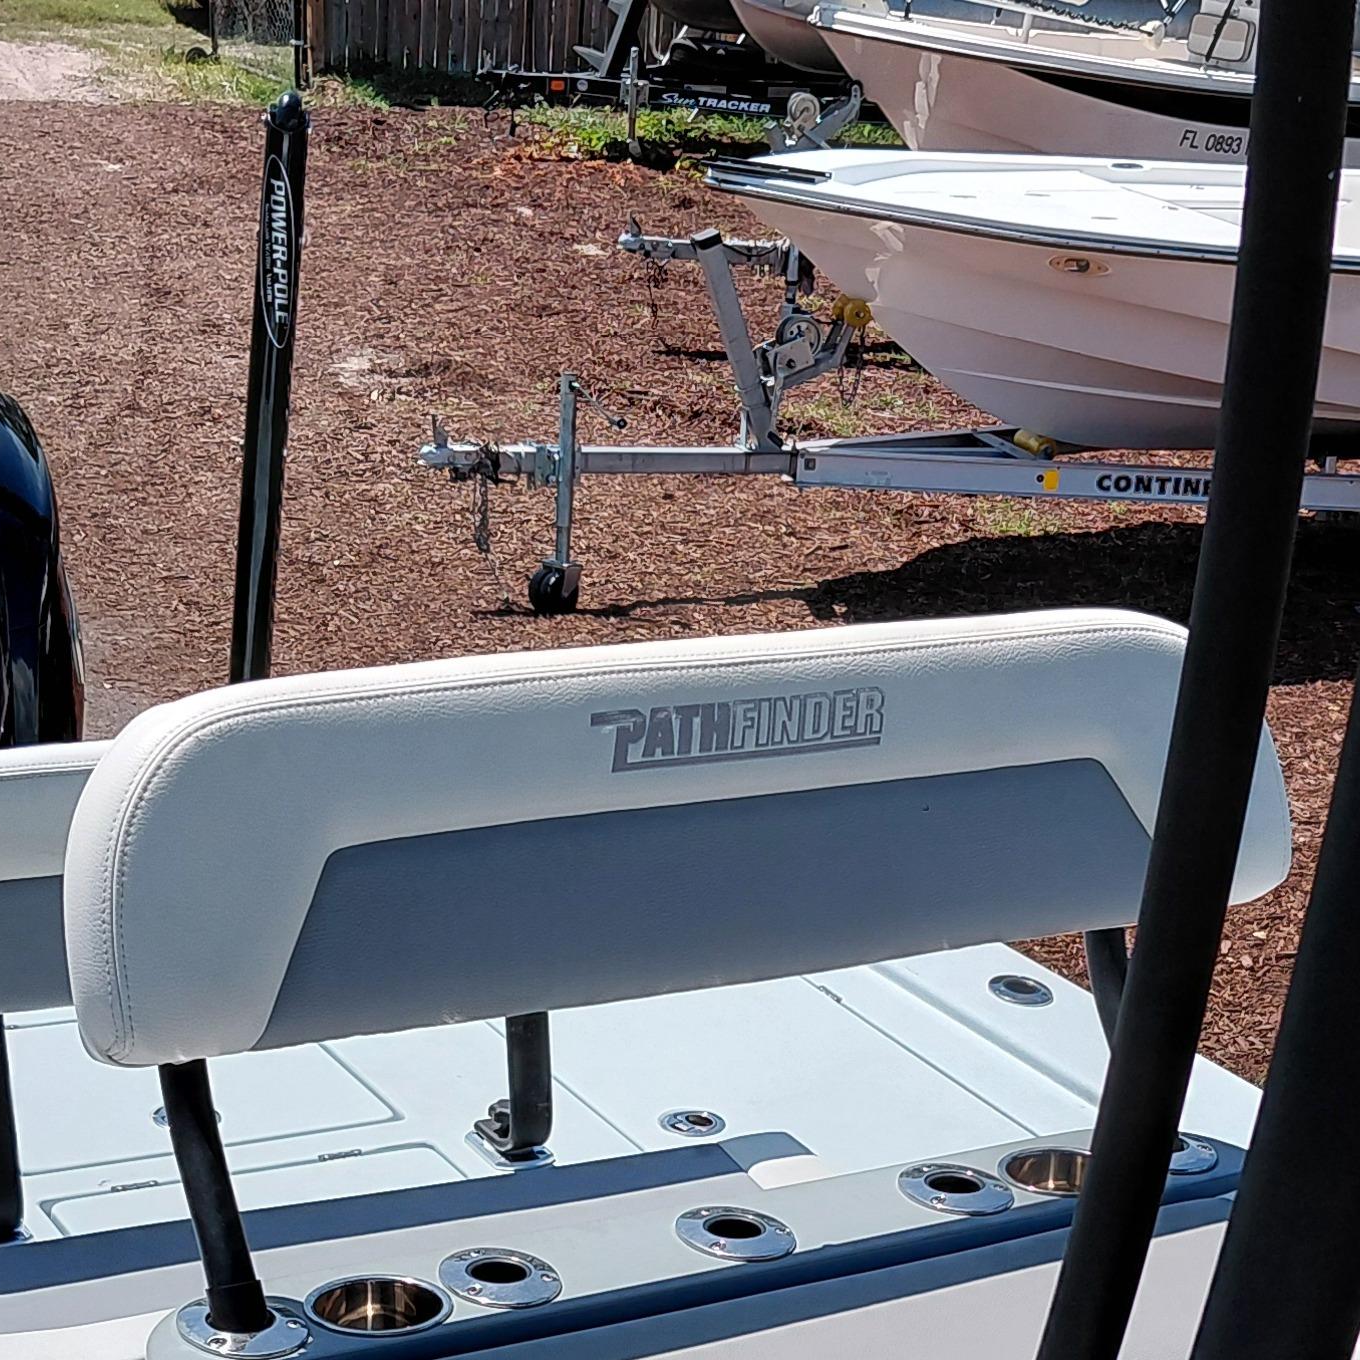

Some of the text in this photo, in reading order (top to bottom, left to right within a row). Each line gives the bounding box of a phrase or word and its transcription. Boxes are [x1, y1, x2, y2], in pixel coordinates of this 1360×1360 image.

[698, 96, 771, 113] TRACKER
[1179, 129, 1199, 149] FL
[1205, 133, 1242, 154] 0893
[270, 178, 289, 324] POWER-POLE
[590, 685, 885, 773] PATHFINDER
